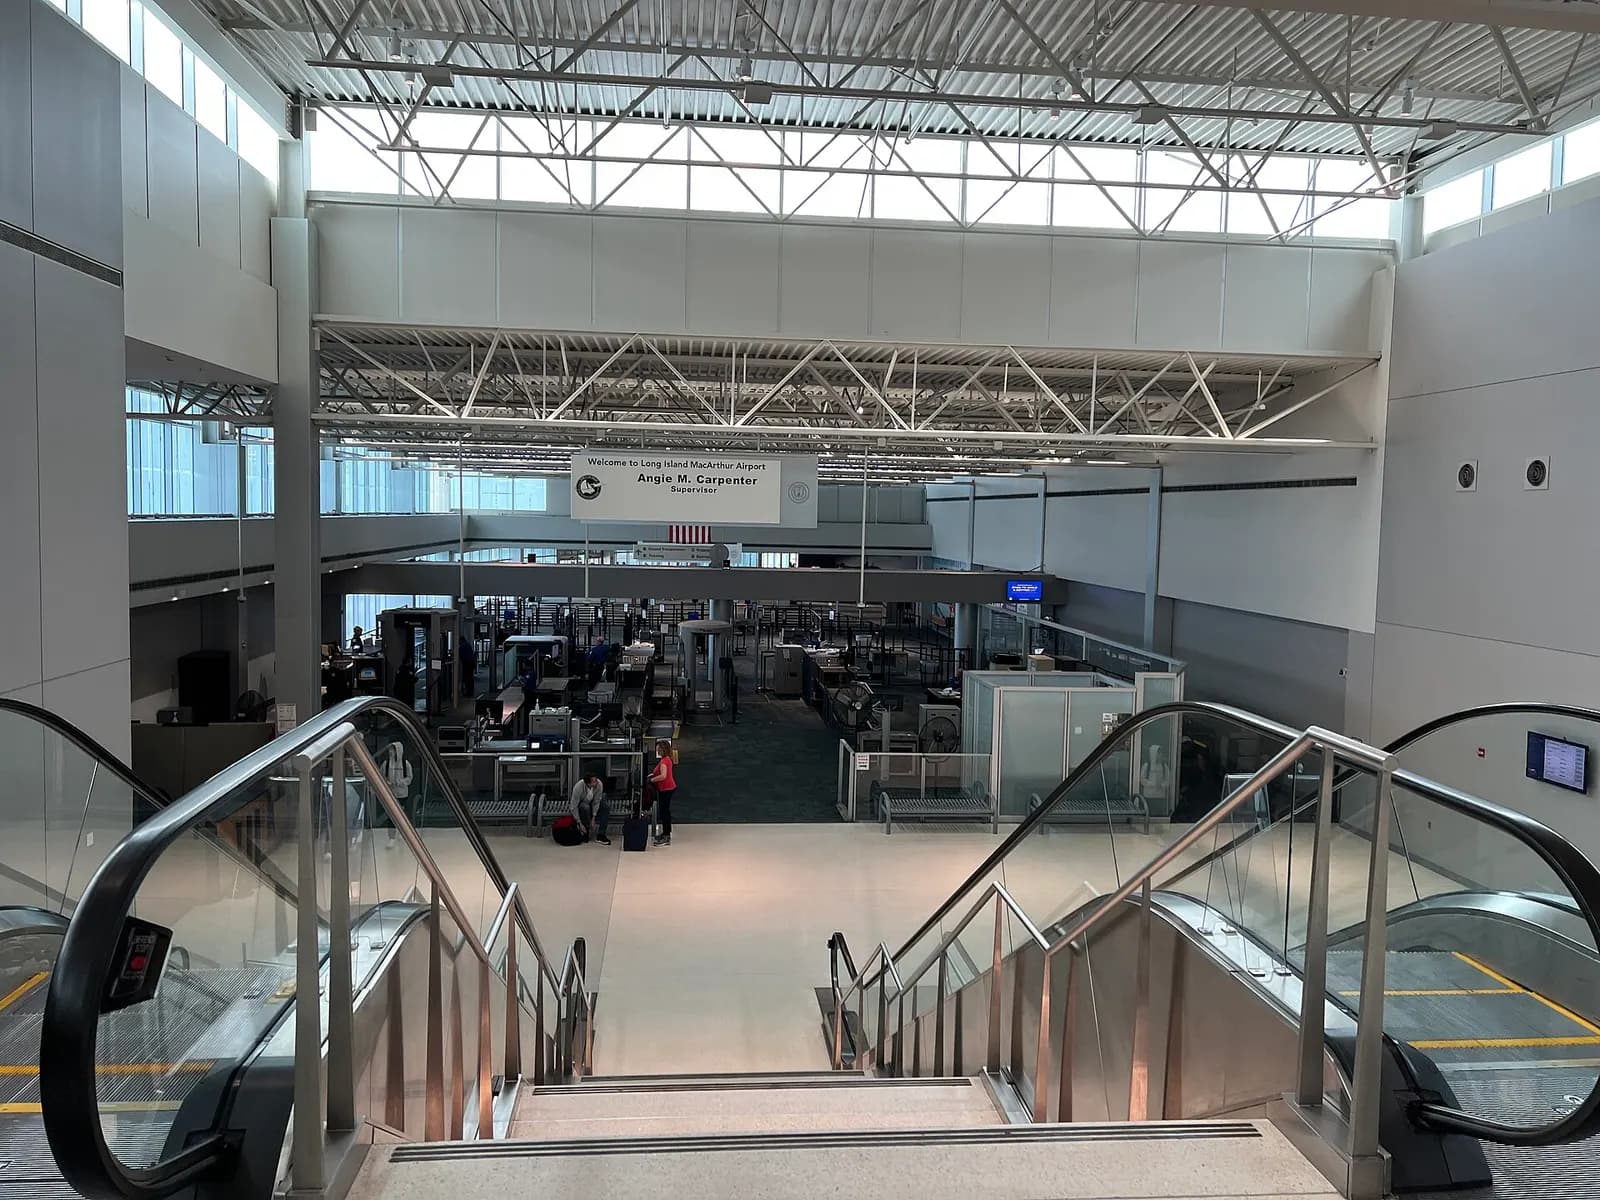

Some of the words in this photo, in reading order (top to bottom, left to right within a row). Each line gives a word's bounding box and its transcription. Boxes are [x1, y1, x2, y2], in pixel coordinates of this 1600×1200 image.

[587, 457, 627, 467] Welcome
[629, 459, 639, 467] to
[641, 459, 662, 470] Long
[664, 459, 688, 468] Island
[690, 460, 734, 470] MacArthur
[735, 462, 766, 472] Airport
[637, 473, 673, 485] Angie
[677, 474, 692, 484] M.
[696, 474, 758, 486] Carpenter
[670, 485, 718, 494] Supervisor
